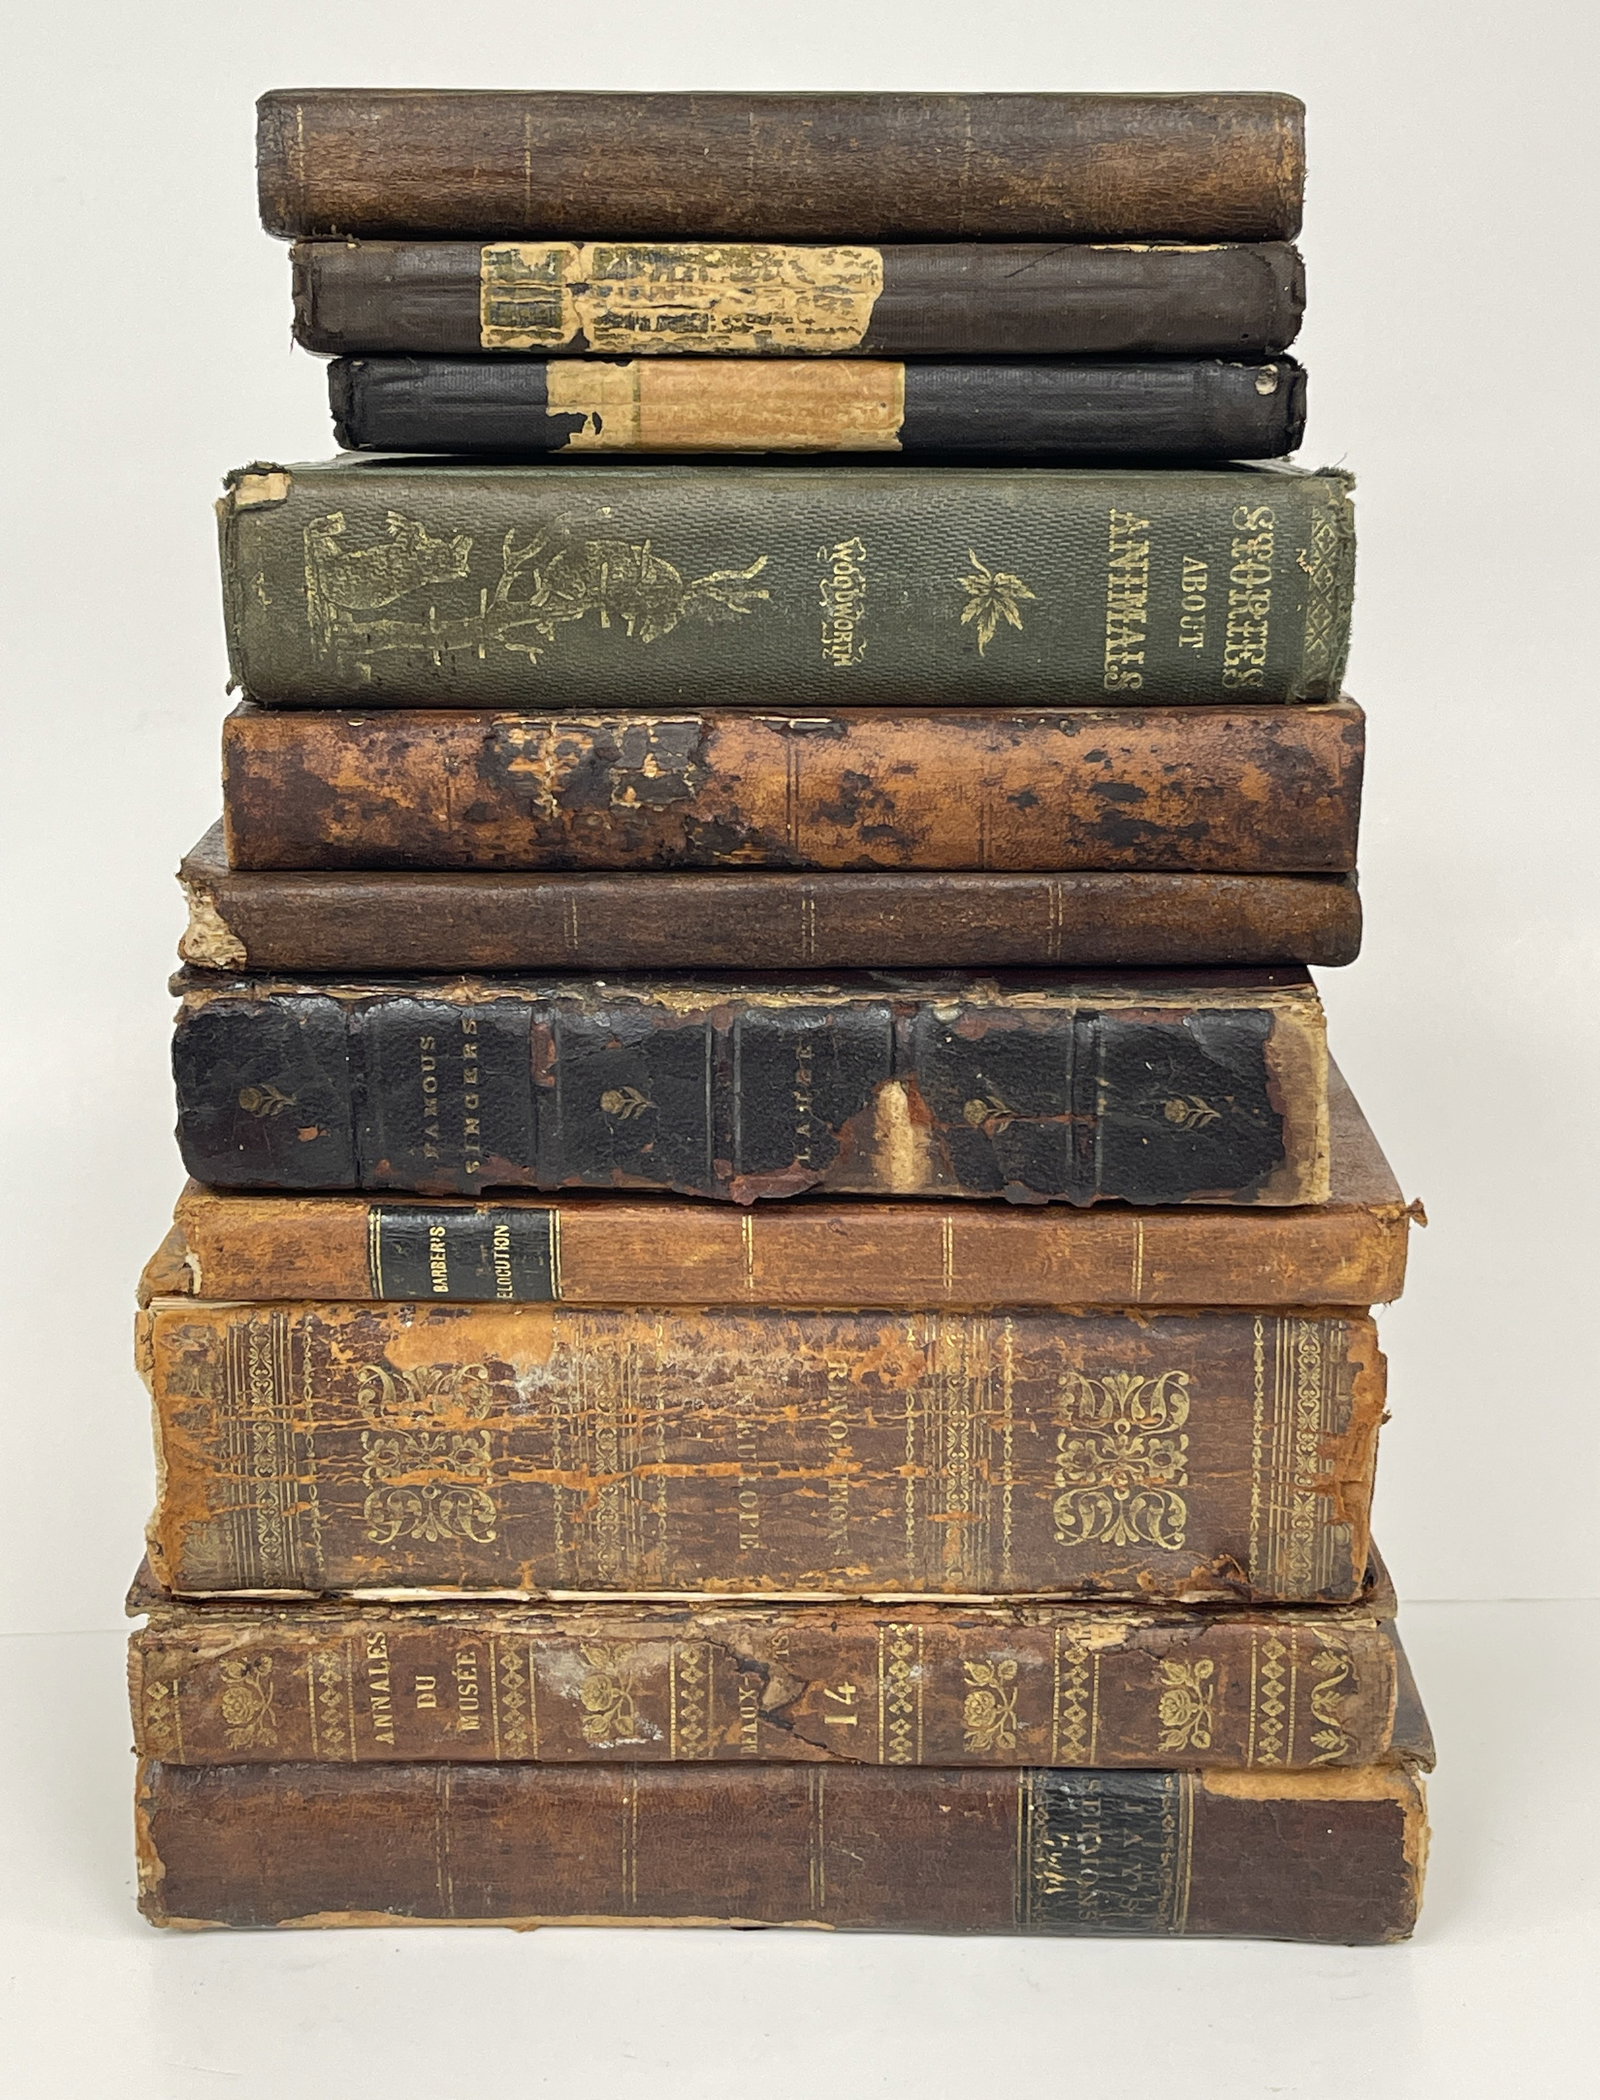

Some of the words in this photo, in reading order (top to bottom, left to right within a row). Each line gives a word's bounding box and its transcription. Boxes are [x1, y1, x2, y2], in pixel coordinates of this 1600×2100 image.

[828, 536, 864, 667] WOODWORTH
[1104, 508, 1149, 692] ANIMALS
[1179, 555, 1208, 648] ABOUT
[1223, 505, 1275, 690] STORIES
[419, 1035, 440, 1160] FAMOUS
[460, 1018, 481, 1175] SINGERS
[428, 1225, 451, 1293] BARBER'S
[493, 1225, 514, 1299] ELOCUTION
[827, 1360, 854, 1557] REVOLTIONS
[366, 1631, 396, 1745] ANNALES
[415, 1675, 438, 1710] DU
[451, 1650, 481, 1732] MUSÉE
[822, 1681, 859, 1727] 14
